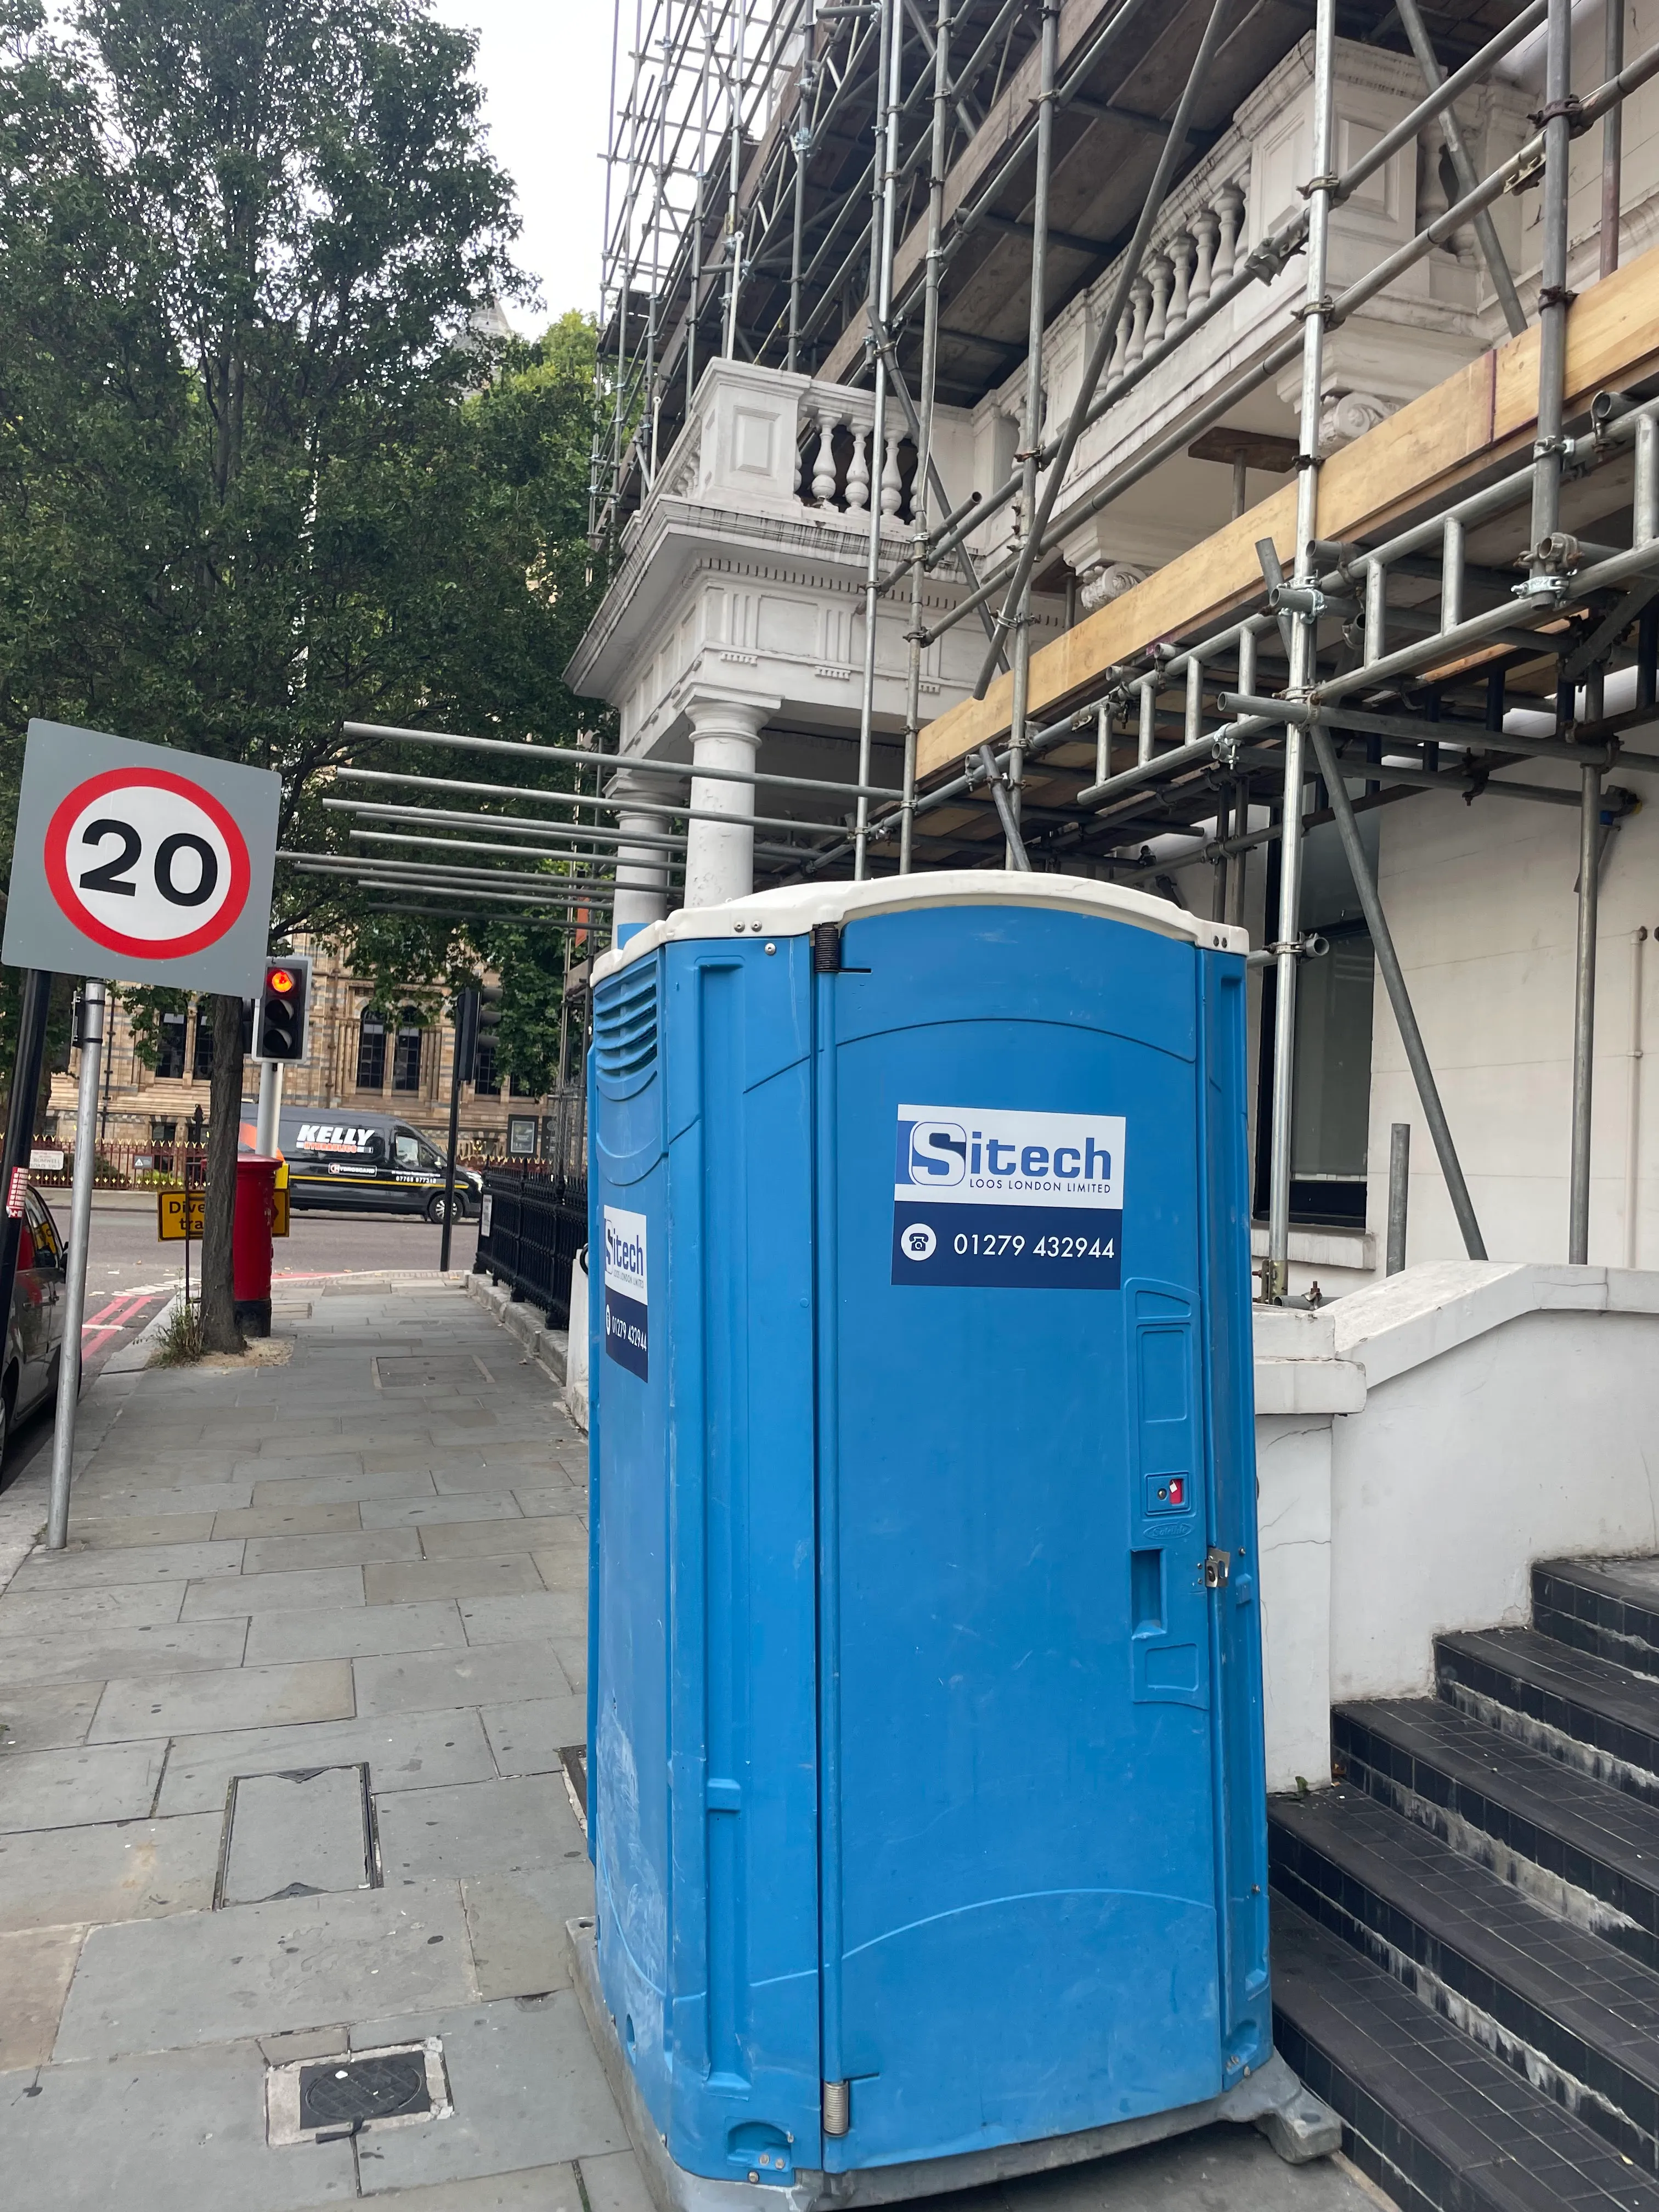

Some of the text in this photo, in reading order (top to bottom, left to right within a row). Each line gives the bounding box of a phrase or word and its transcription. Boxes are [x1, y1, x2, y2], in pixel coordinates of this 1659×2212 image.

[79, 819, 218, 906] 20
[297, 1125, 375, 1146] KELLY
[909, 1122, 1111, 1187] Sitech
[970, 1178, 1111, 1193] LOOS LONDON LIMITED
[170, 1201, 206, 1214] Dive
[179, 1218, 203, 1230] tra
[605, 1219, 644, 1276] Sitech
[953, 1233, 1115, 1259] 01279 432944
[620, 1272, 633, 1284] LONDON
[612, 1315, 647, 1352] 01279 432944
